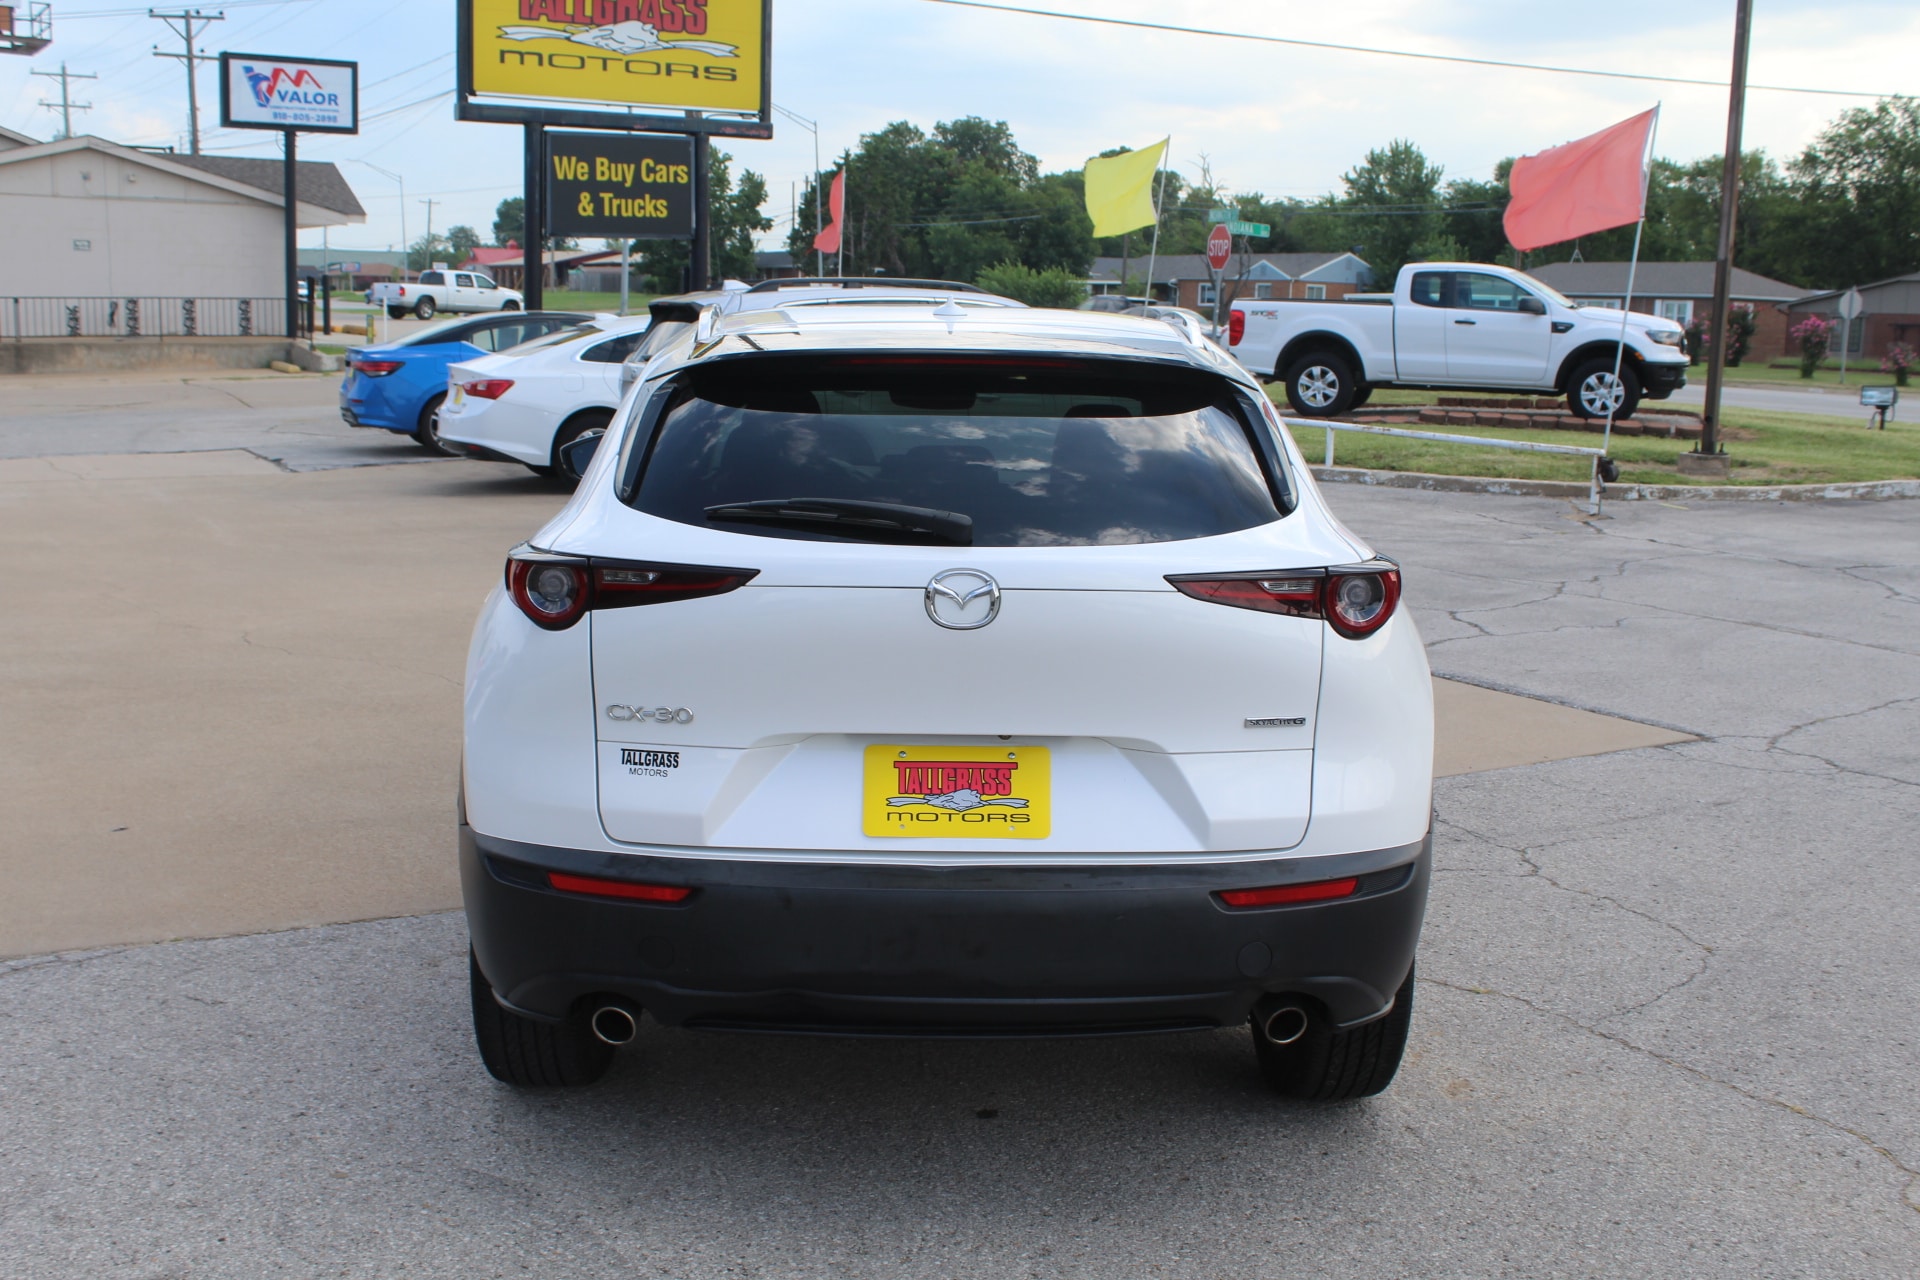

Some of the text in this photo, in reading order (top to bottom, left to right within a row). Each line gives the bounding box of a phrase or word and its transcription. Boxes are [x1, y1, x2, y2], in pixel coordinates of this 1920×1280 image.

[499, 49, 738, 82] MOTORS
[276, 89, 339, 106] VALOR
[553, 155, 689, 187] We Buy Cars
[577, 191, 668, 218] & Trucks
[1209, 239, 1229, 257] STOP
[606, 703, 694, 725] CX-30
[621, 748, 680, 768] TALLGRASS
[629, 767, 668, 778] MOTORS
[893, 760, 1018, 796] TALLGRASS
[886, 811, 1031, 823] MOTORS
